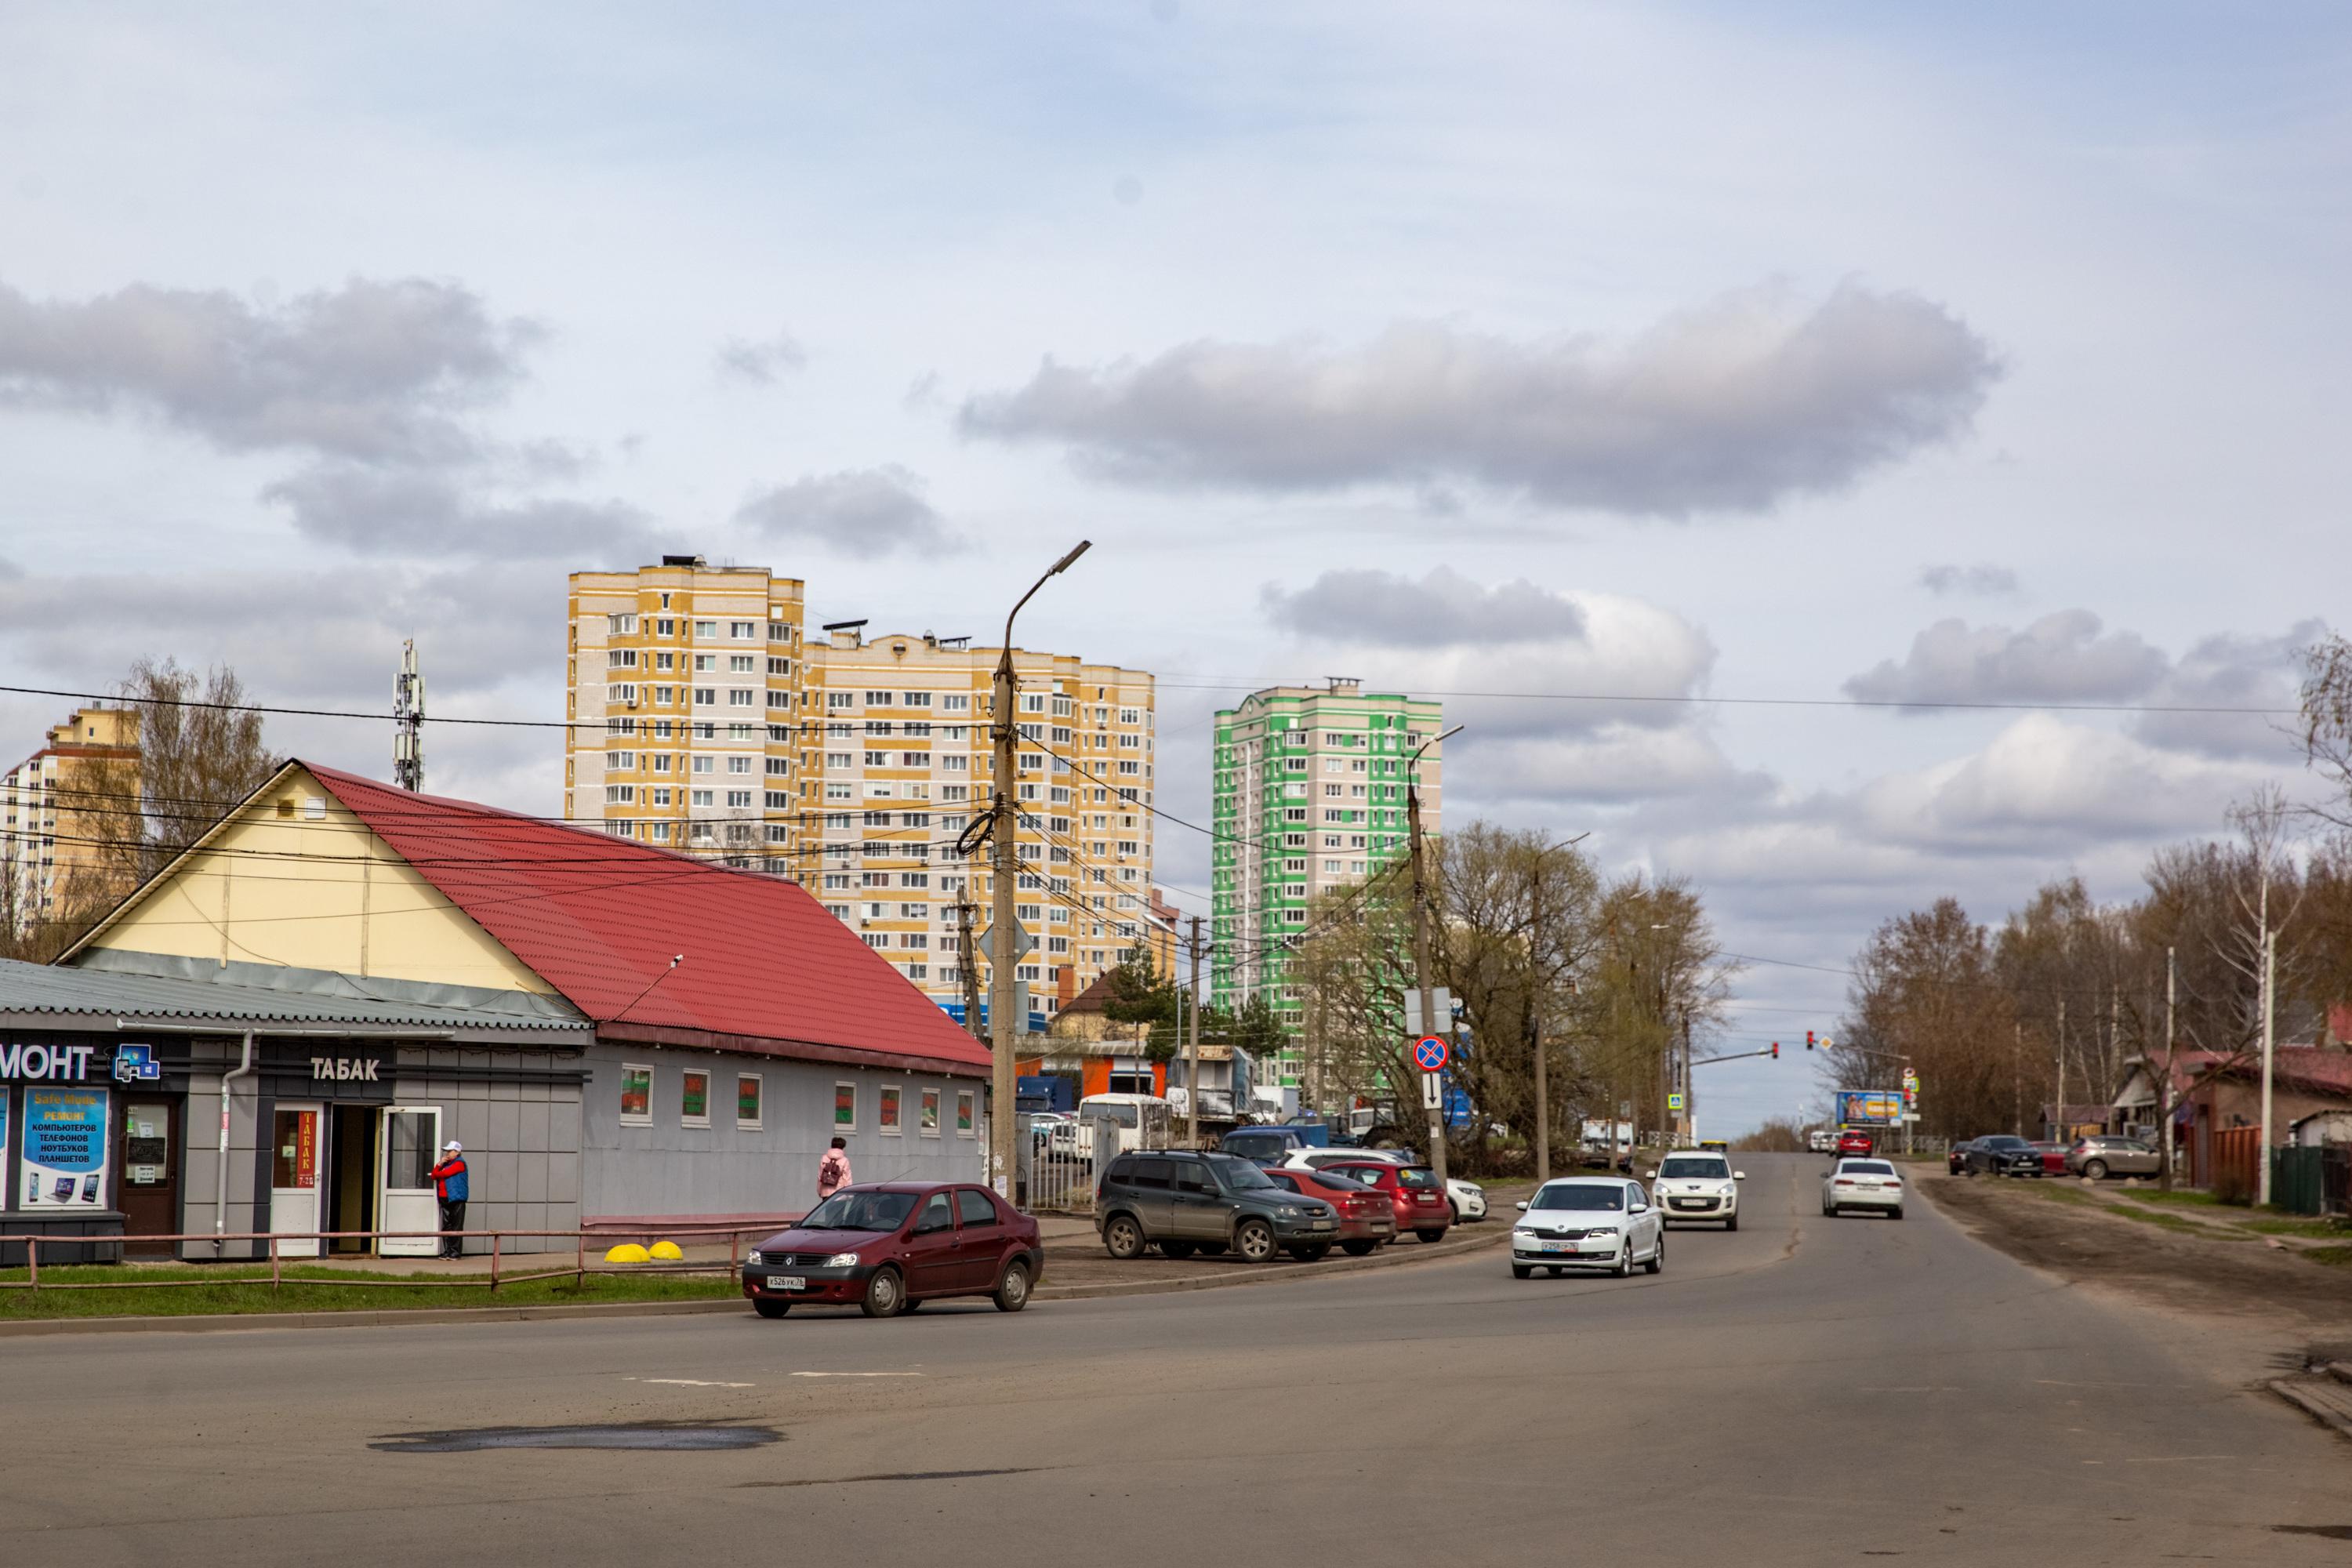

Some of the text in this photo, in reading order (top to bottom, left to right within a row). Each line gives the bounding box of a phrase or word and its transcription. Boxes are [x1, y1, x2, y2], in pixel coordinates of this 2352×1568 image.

[0, 1044, 94, 1080] МОНТ
[311, 1058, 379, 1080] ТАБАК
[34, 1092, 61, 1105] Safe
[44, 1112, 85, 1120] РЕМОНТ
[303, 1112, 312, 1169] ТАБАК
